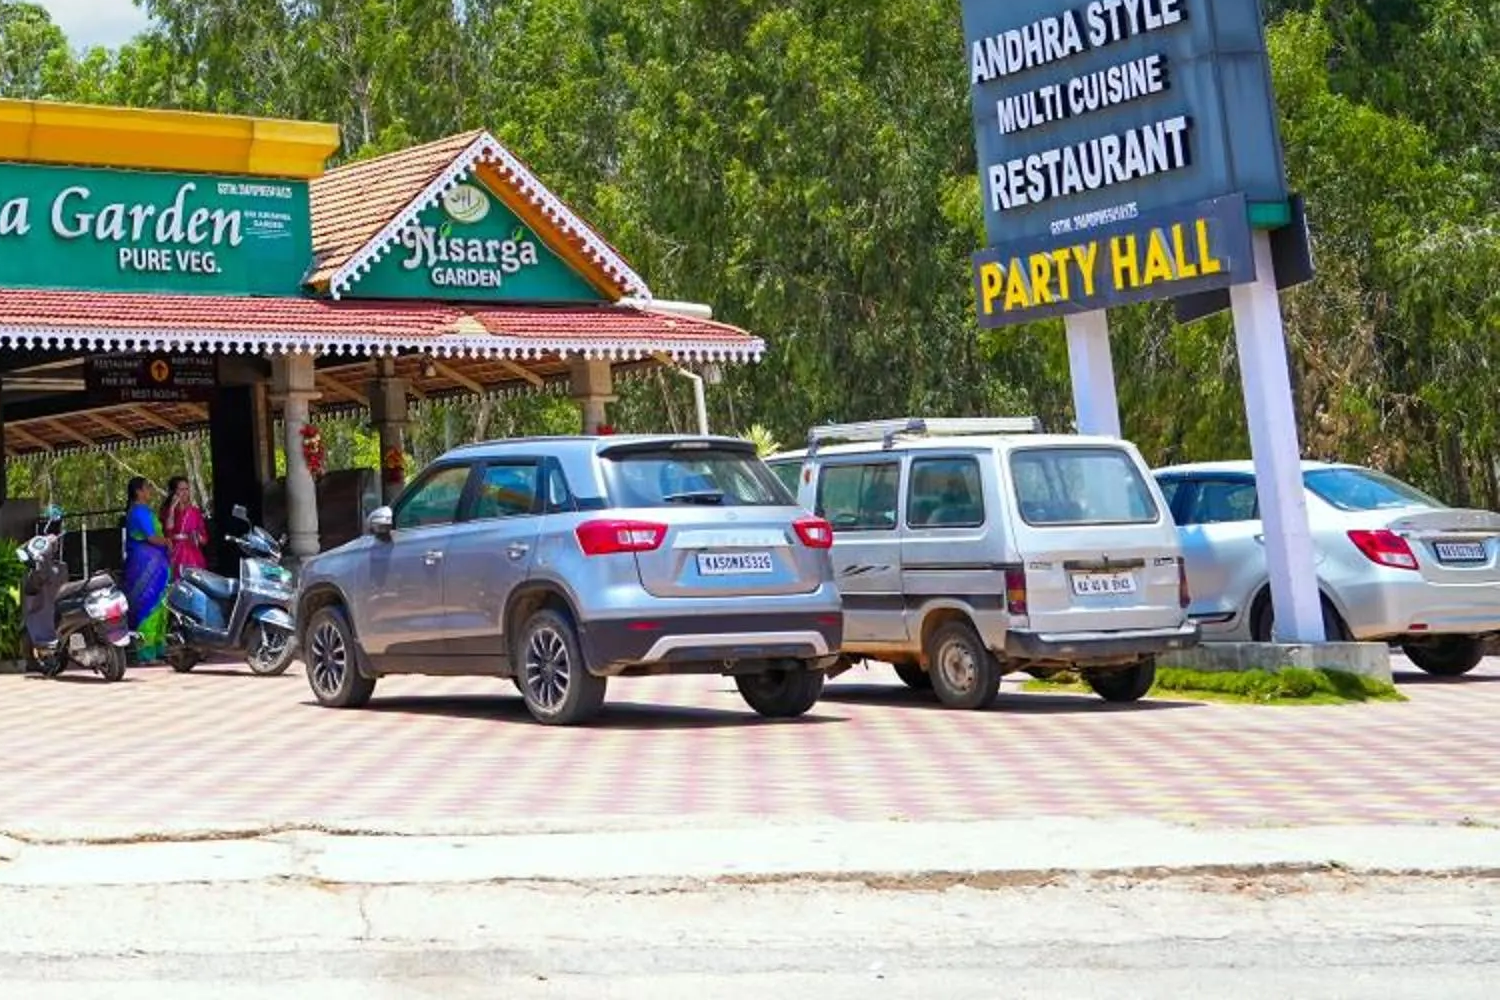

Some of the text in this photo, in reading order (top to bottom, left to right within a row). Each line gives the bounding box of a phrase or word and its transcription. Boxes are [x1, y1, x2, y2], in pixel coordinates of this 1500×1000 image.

[971, 10, 1083, 85] ANDHRA
[997, 54, 1163, 135] MULTI CUISINE
[988, 116, 1187, 211] RESTAURANT
[51, 182, 244, 247] Garden
[402, 225, 539, 273] Nisarga
[119, 248, 222, 274] PURE VEG.
[431, 267, 501, 287] GARDEN
[980, 241, 1097, 315] PARTY
[1111, 218, 1221, 290] HALL
